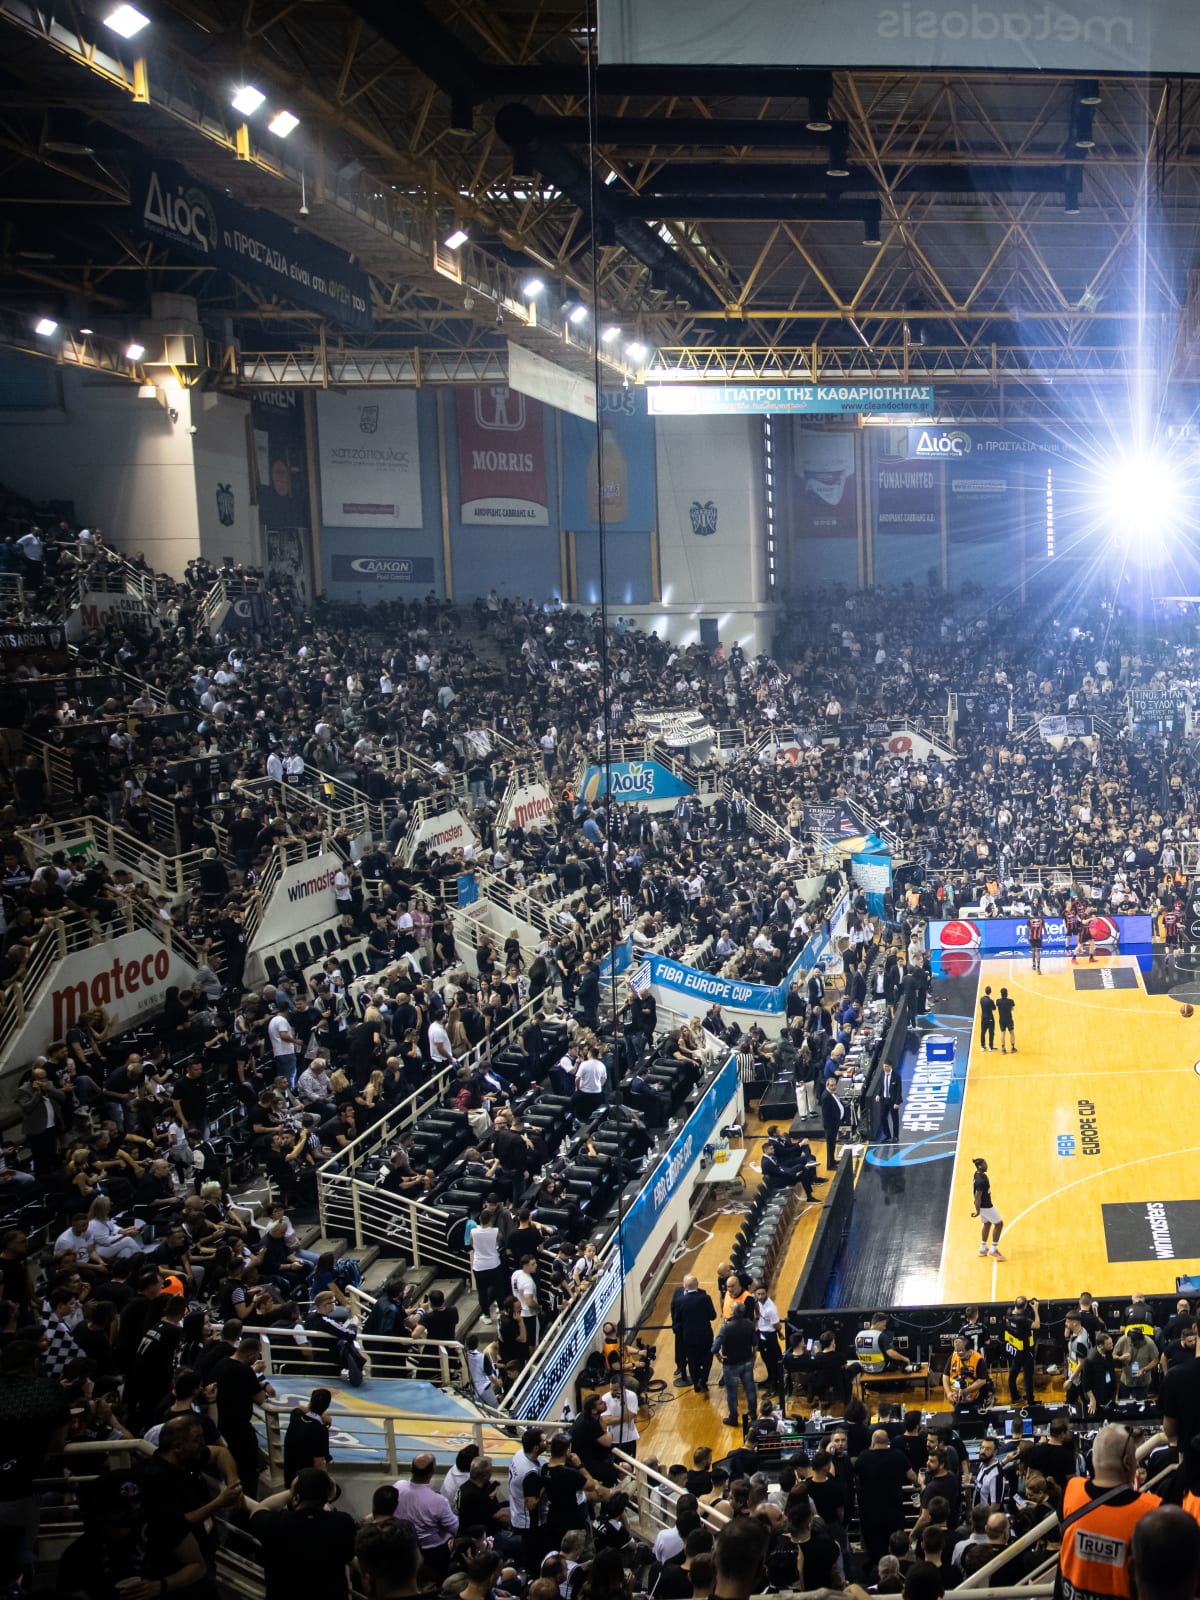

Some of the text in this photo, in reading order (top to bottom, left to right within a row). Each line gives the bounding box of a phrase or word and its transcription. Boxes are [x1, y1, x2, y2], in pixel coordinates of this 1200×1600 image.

[233, 229, 288, 275] ΠΡΟΣΤΑΣΙΑ
[784, 387, 813, 401] ΤΗΣ
[817, 386, 930, 401] ΚΑΘΑΡΙΟΤΗΤΑΣ
[916, 431, 963, 457] Διός
[472, 449, 534, 472] MORRIS
[611, 769, 655, 794] λουξ
[287, 867, 342, 903] winmaste
[1016, 921, 1066, 936] mten
[52, 948, 171, 1043] mateco
[655, 963, 753, 1003] FIBA EUROPE CUP
[1078, 1099, 1101, 1156] EUROPE CUP
[1057, 1133, 1077, 1157] FIBA
[1149, 1201, 1175, 1260] winmasters
[1077, 1530, 1125, 1558] TRUST
